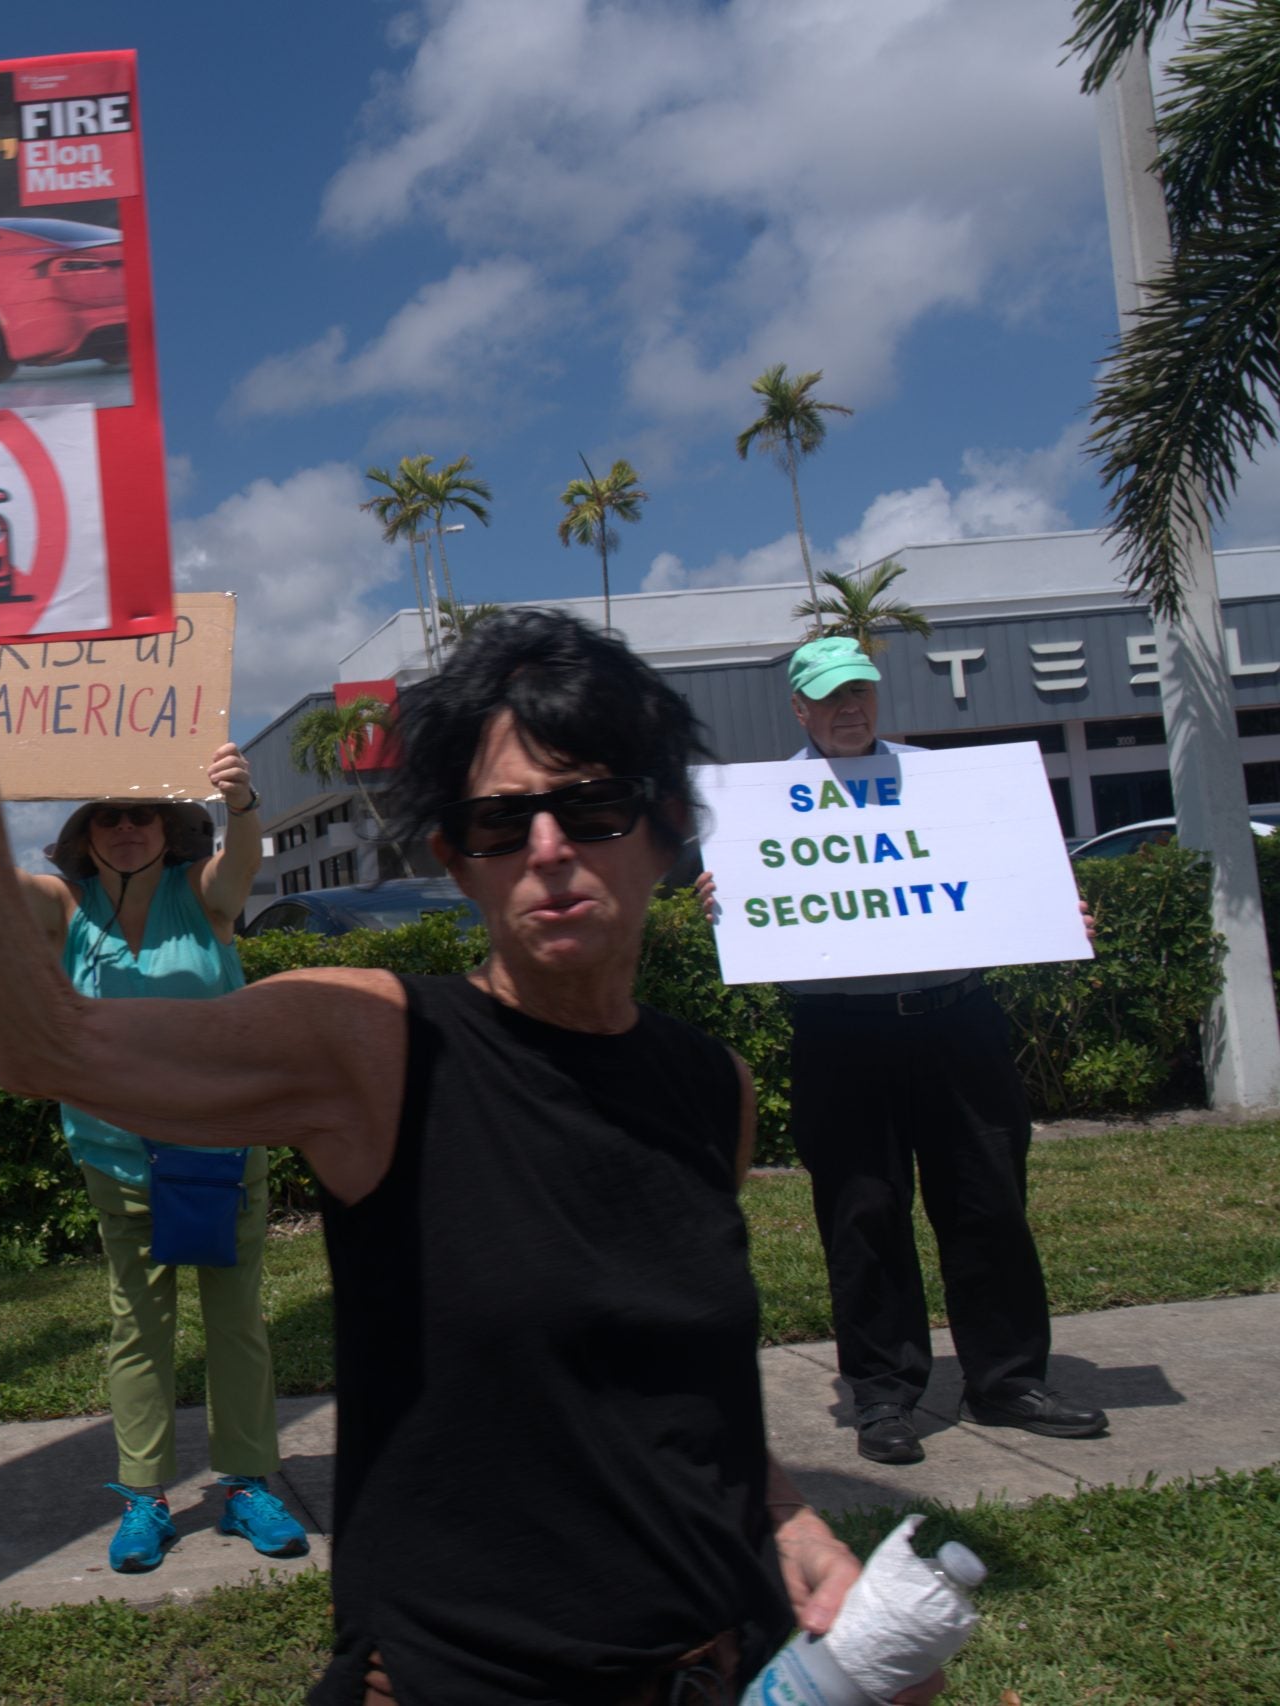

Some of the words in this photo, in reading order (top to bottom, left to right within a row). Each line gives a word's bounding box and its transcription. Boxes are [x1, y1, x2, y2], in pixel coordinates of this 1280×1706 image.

[22, 95, 131, 140] FIRE
[24, 139, 102, 168] Elon
[26, 165, 114, 193] Musk
[790, 776, 901, 813] SAVE
[759, 829, 930, 869] SOCIAL
[744, 881, 970, 928] SECURITY
